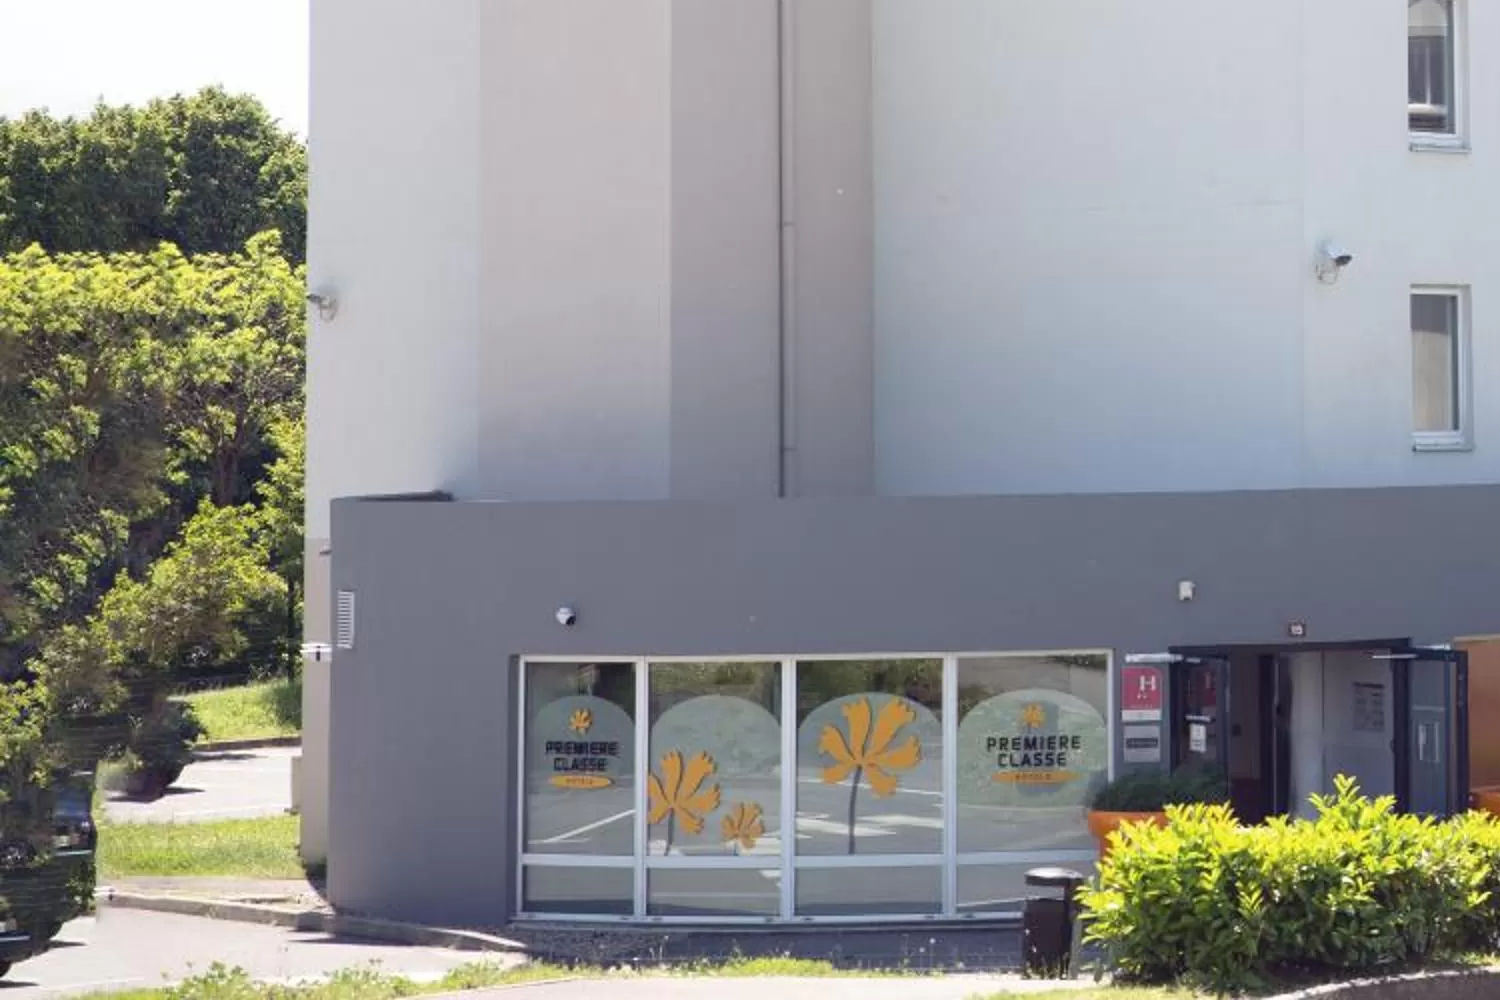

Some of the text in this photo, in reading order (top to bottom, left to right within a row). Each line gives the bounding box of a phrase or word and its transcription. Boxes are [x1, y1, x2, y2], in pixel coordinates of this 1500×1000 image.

[1139, 675, 1156, 691] H
[546, 741, 619, 756] PREMIERE
[986, 735, 1081, 752] PREMIERE
[553, 757, 608, 772] CLASSE
[998, 751, 1067, 767] CLASSE
